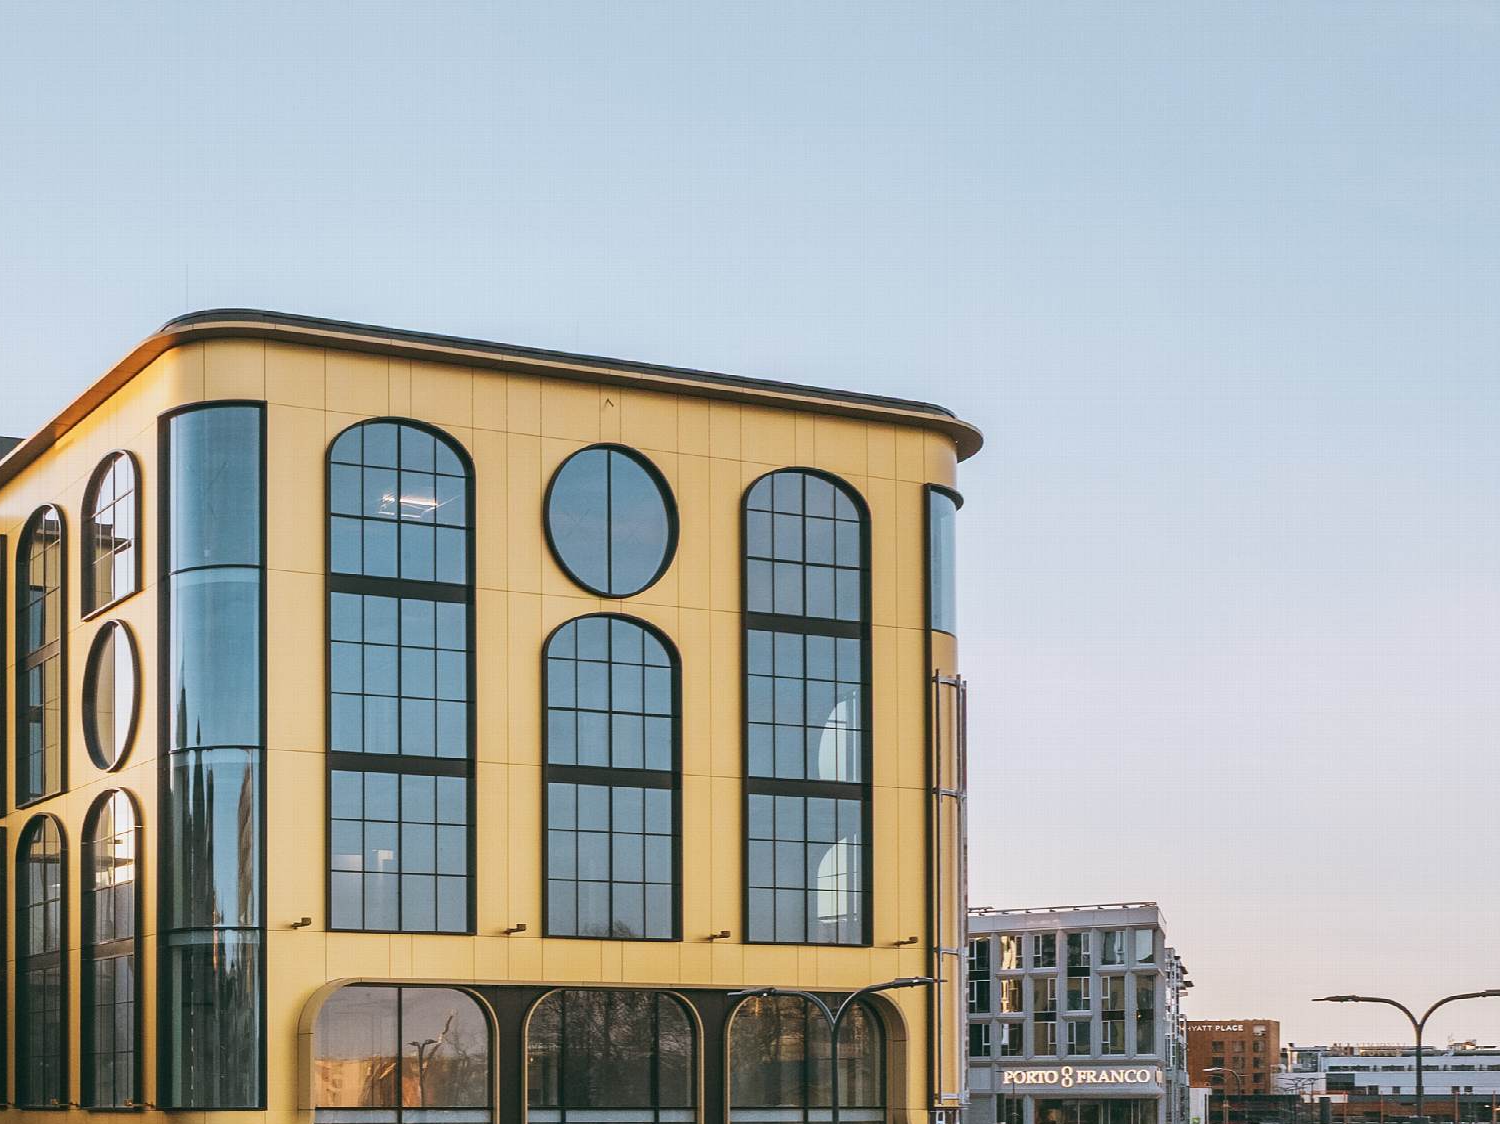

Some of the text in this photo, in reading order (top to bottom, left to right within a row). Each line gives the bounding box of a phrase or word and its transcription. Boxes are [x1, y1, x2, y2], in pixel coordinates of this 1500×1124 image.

[1215, 1024, 1244, 1032] PLACE
[1003, 1069, 1151, 1084] PORTO FRANCO
